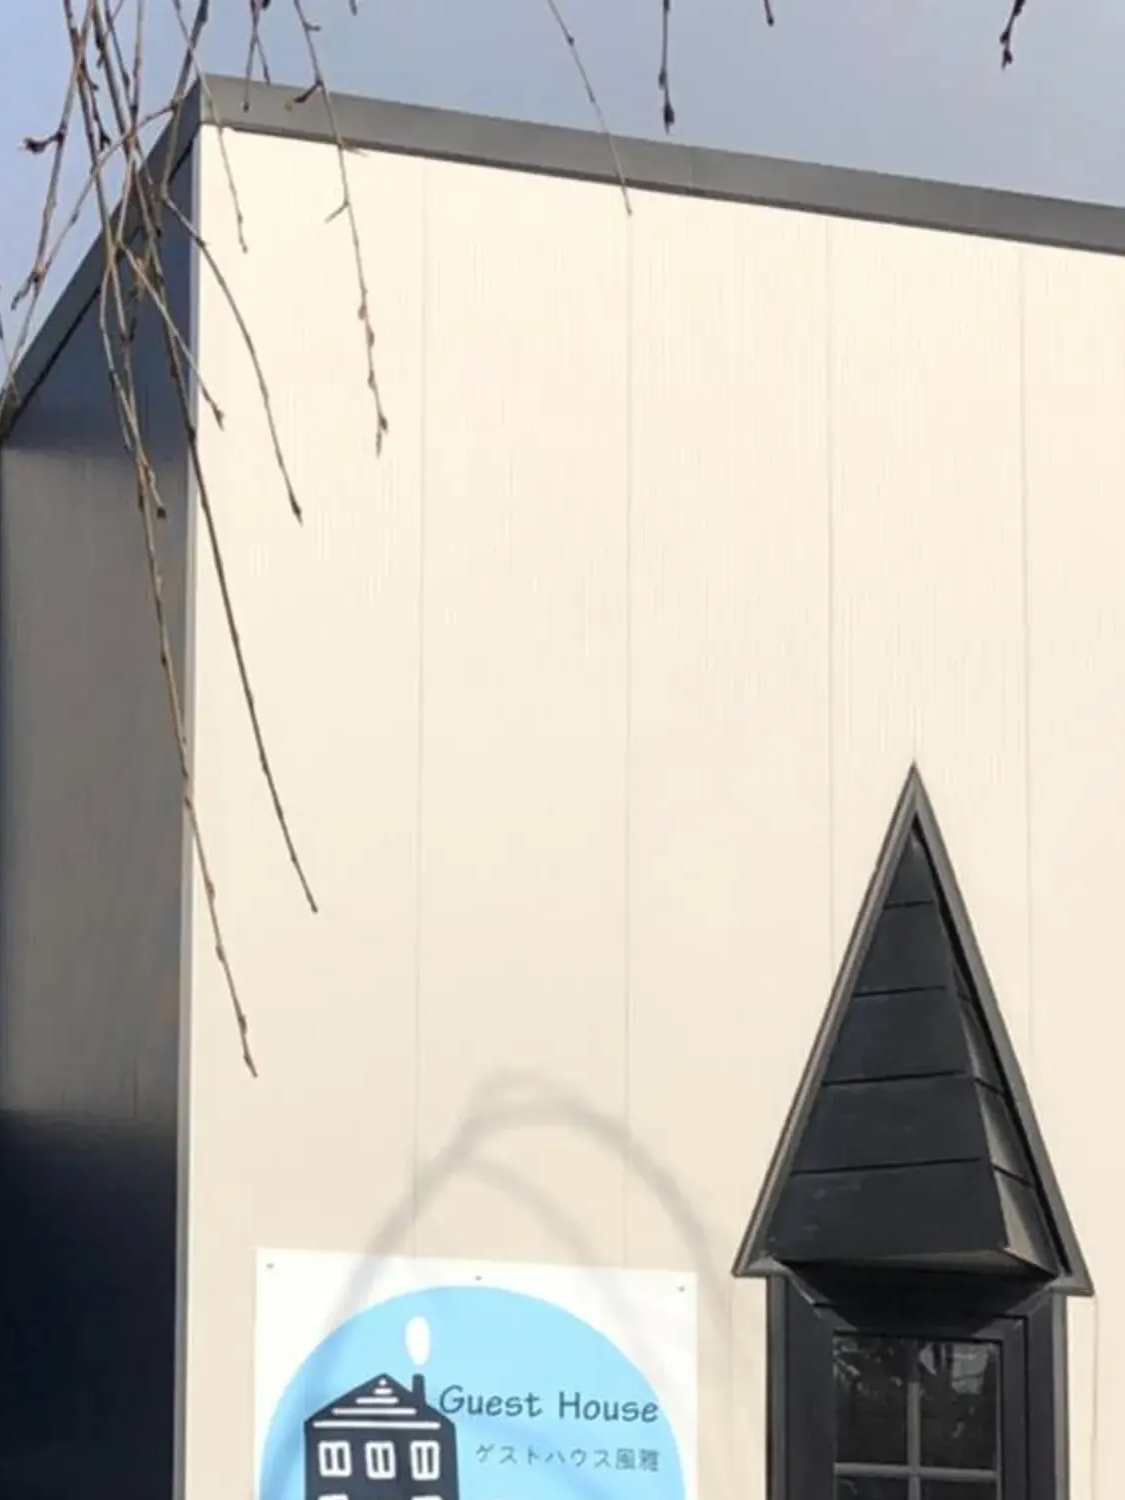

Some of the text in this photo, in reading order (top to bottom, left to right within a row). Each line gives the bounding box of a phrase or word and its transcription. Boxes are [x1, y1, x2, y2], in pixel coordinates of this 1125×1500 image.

[439, 1384, 659, 1423] Guest House
[475, 1442, 661, 1472] ゲストハウス風雅
